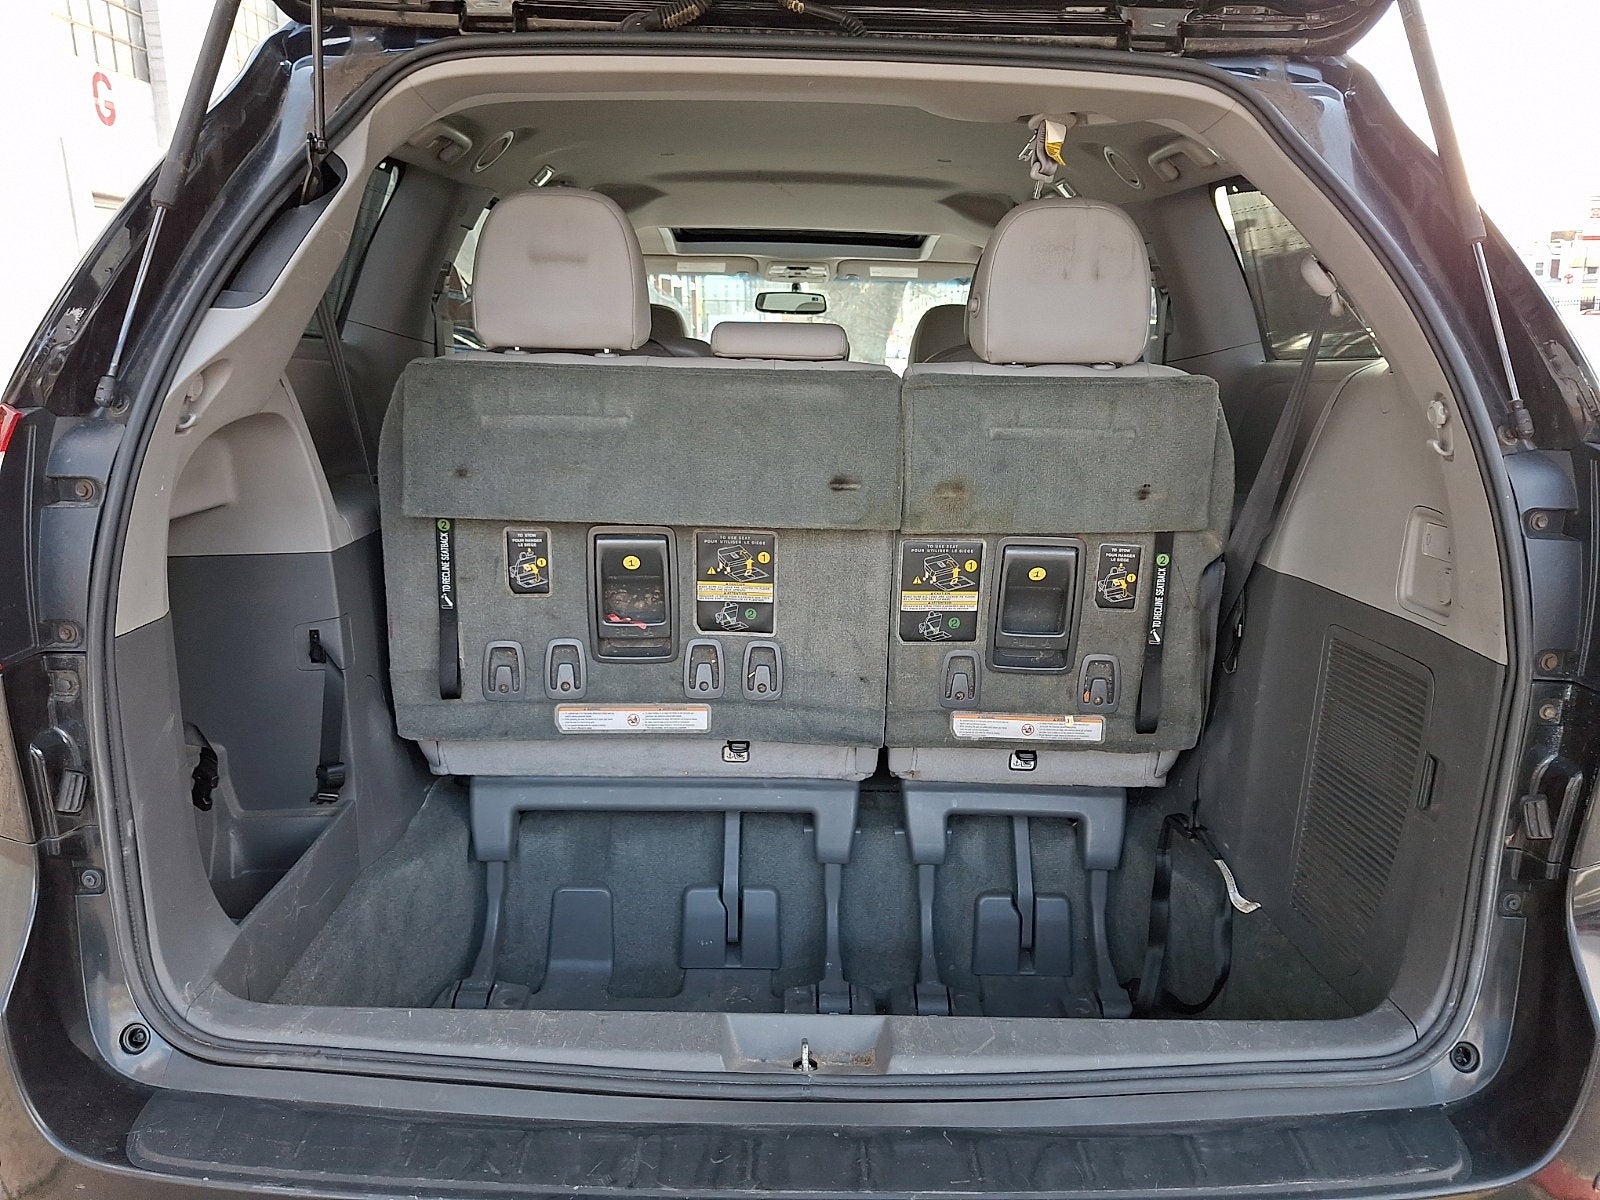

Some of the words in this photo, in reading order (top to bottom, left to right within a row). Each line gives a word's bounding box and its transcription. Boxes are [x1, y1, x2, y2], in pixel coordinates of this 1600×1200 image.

[92, 71, 116, 126] G
[440, 532, 450, 561] SEATBACK
[441, 561, 451, 585] RECLINE
[1155, 567, 1167, 596] SEATBACK
[442, 584, 451, 592] TO
[1153, 596, 1164, 620] RECLINE
[1152, 620, 1162, 628] TO
